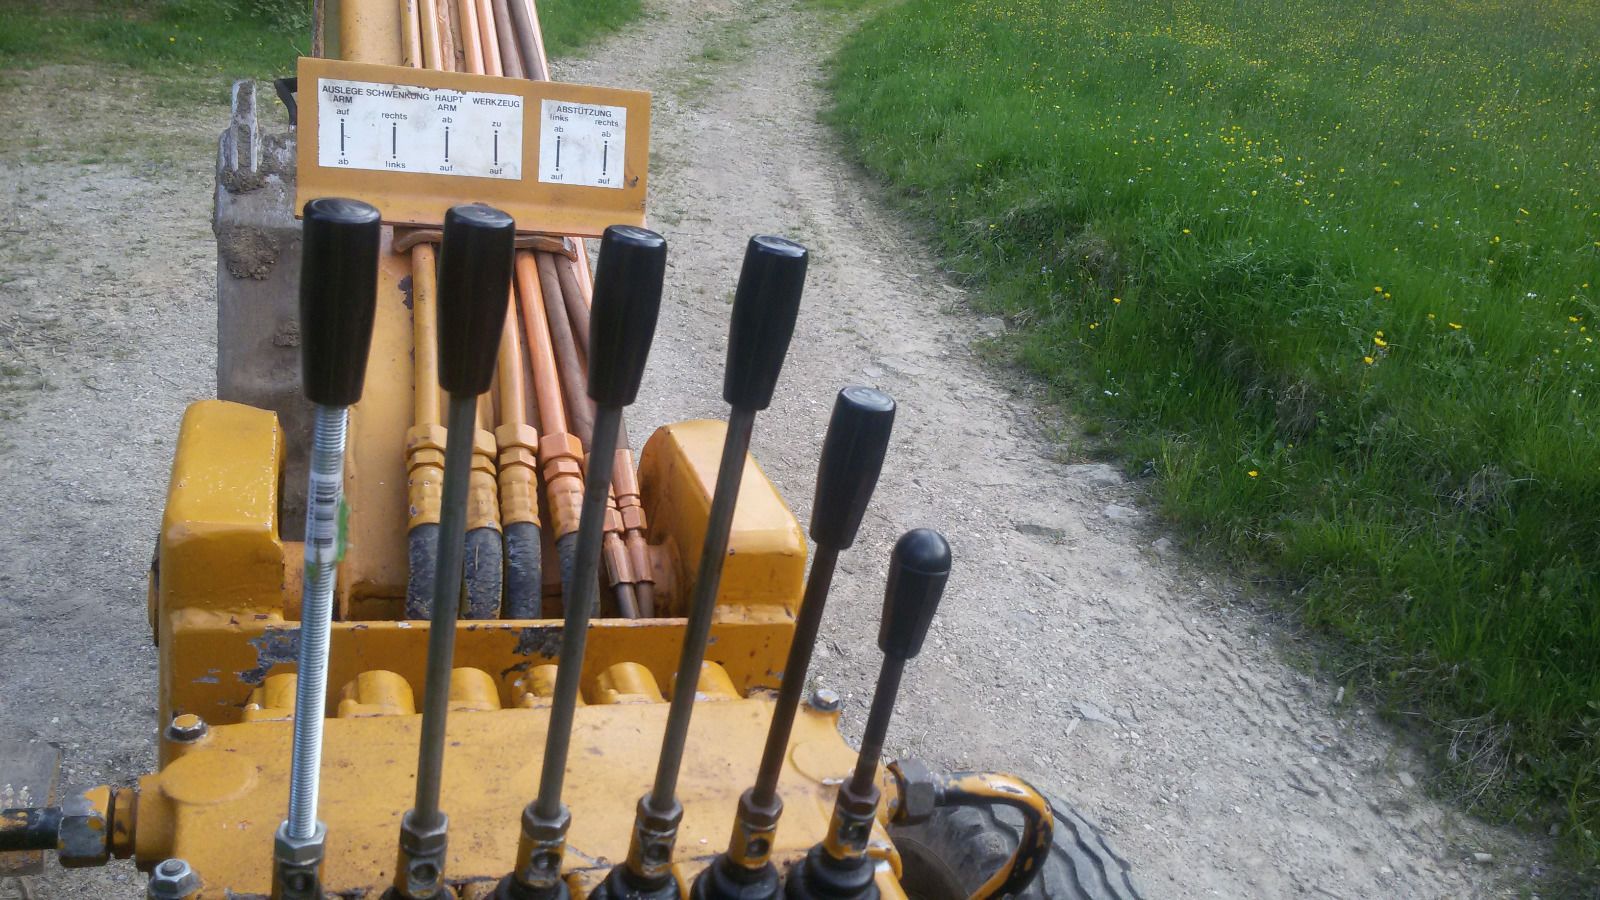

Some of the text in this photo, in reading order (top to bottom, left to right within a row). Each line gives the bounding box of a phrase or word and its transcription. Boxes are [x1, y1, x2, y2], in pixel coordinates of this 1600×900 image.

[322, 85, 363, 96] AUSLEGE
[366, 88, 430, 101] SCHWENKUNG
[332, 95, 353, 104] ARM
[434, 94, 464, 104] HAUPT
[472, 97, 520, 108] WERKZEUG
[437, 103, 457, 112] ARM
[556, 105, 612, 118] ABSTÜTZUNG
[381, 112, 408, 120] rechts
[442, 116, 453, 124] ab
[549, 113, 569, 122] links
[594, 119, 619, 128] rechts
[553, 125, 564, 133] ab
[601, 130, 612, 138] ab
[385, 161, 406, 169] links
[439, 164, 454, 172] auf
[489, 167, 503, 175] auf
[550, 173, 563, 181] auf
[597, 177, 611, 185] auf
